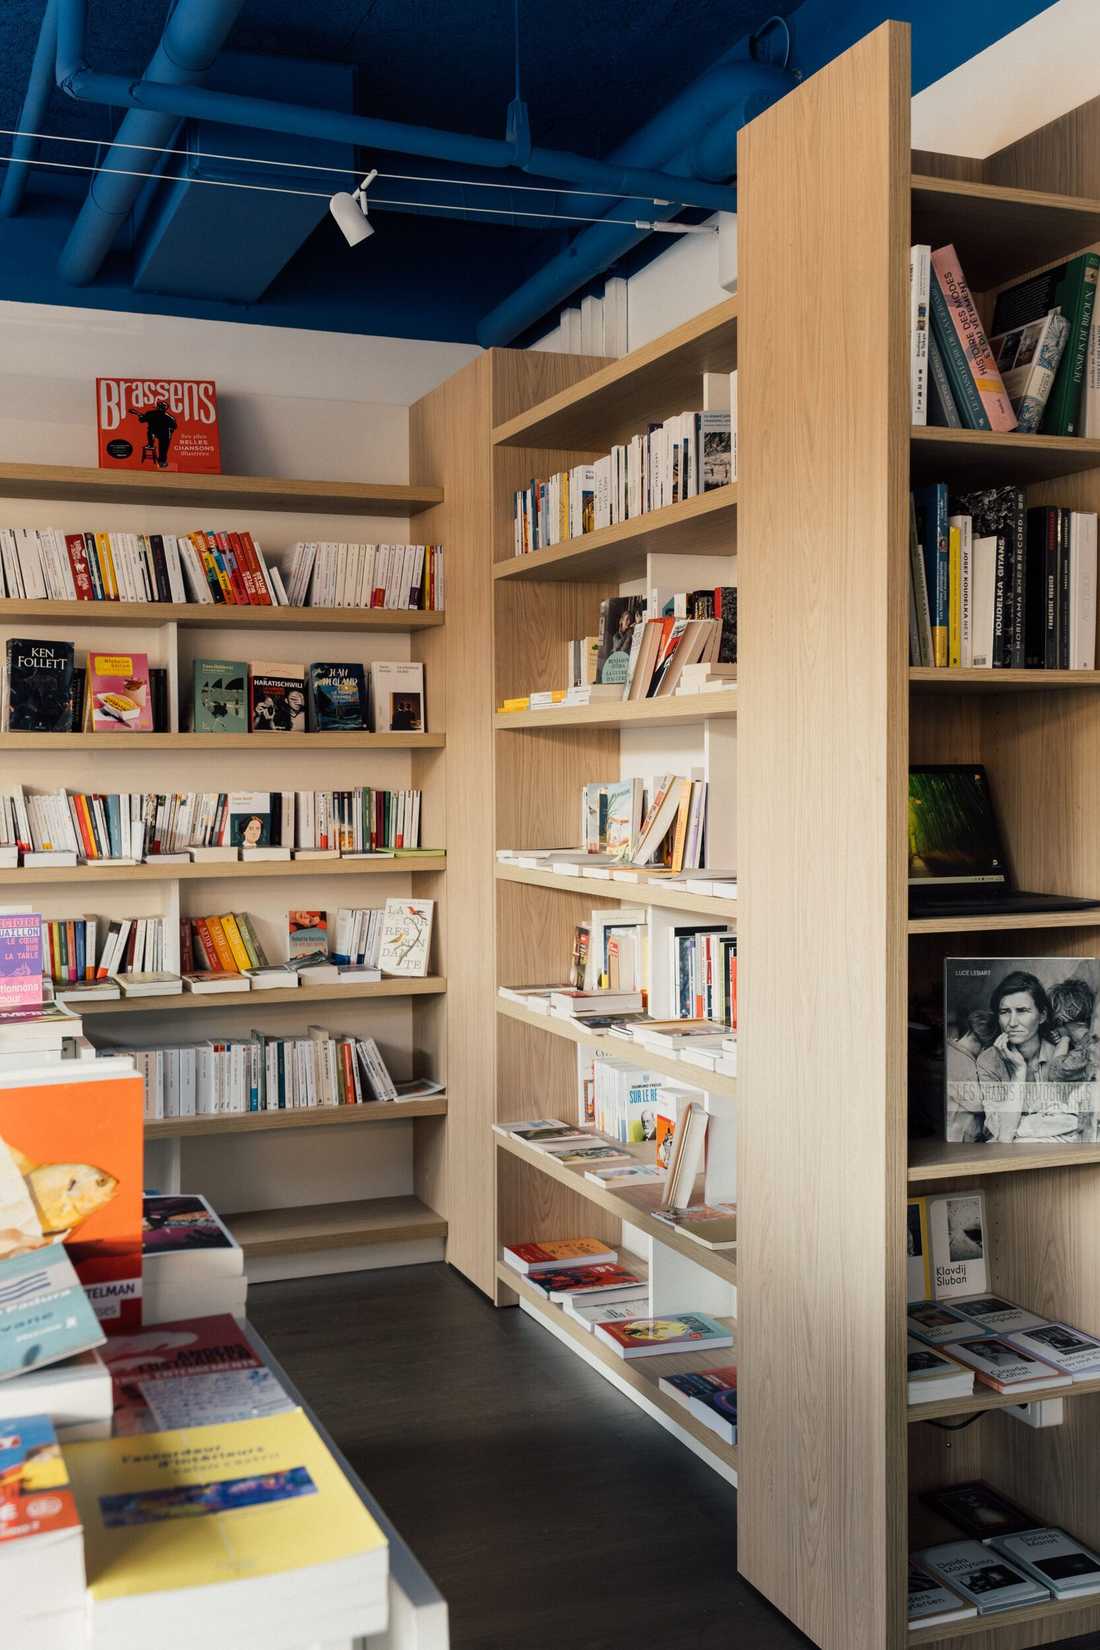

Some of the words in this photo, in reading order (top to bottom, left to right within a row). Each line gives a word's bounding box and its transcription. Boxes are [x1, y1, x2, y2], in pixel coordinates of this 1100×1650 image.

[943, 271, 964, 309] MODES
[957, 311, 971, 330] DES
[966, 333, 988, 376] HISTOIRE
[100, 380, 216, 430] Brassens
[996, 581, 1004, 636] KOUDELKA
[31, 647, 54, 657] KEN
[18, 656, 67, 670] FOLLETT
[0, 927, 39, 937] UAILLON
[629, 1090, 641, 1104] SUR
[642, 1089, 651, 1102] LE
[936, 1264, 967, 1276] Klavdij
[936, 1275, 967, 1287] Sluban
[85, 1283, 135, 1299] TELMAN
